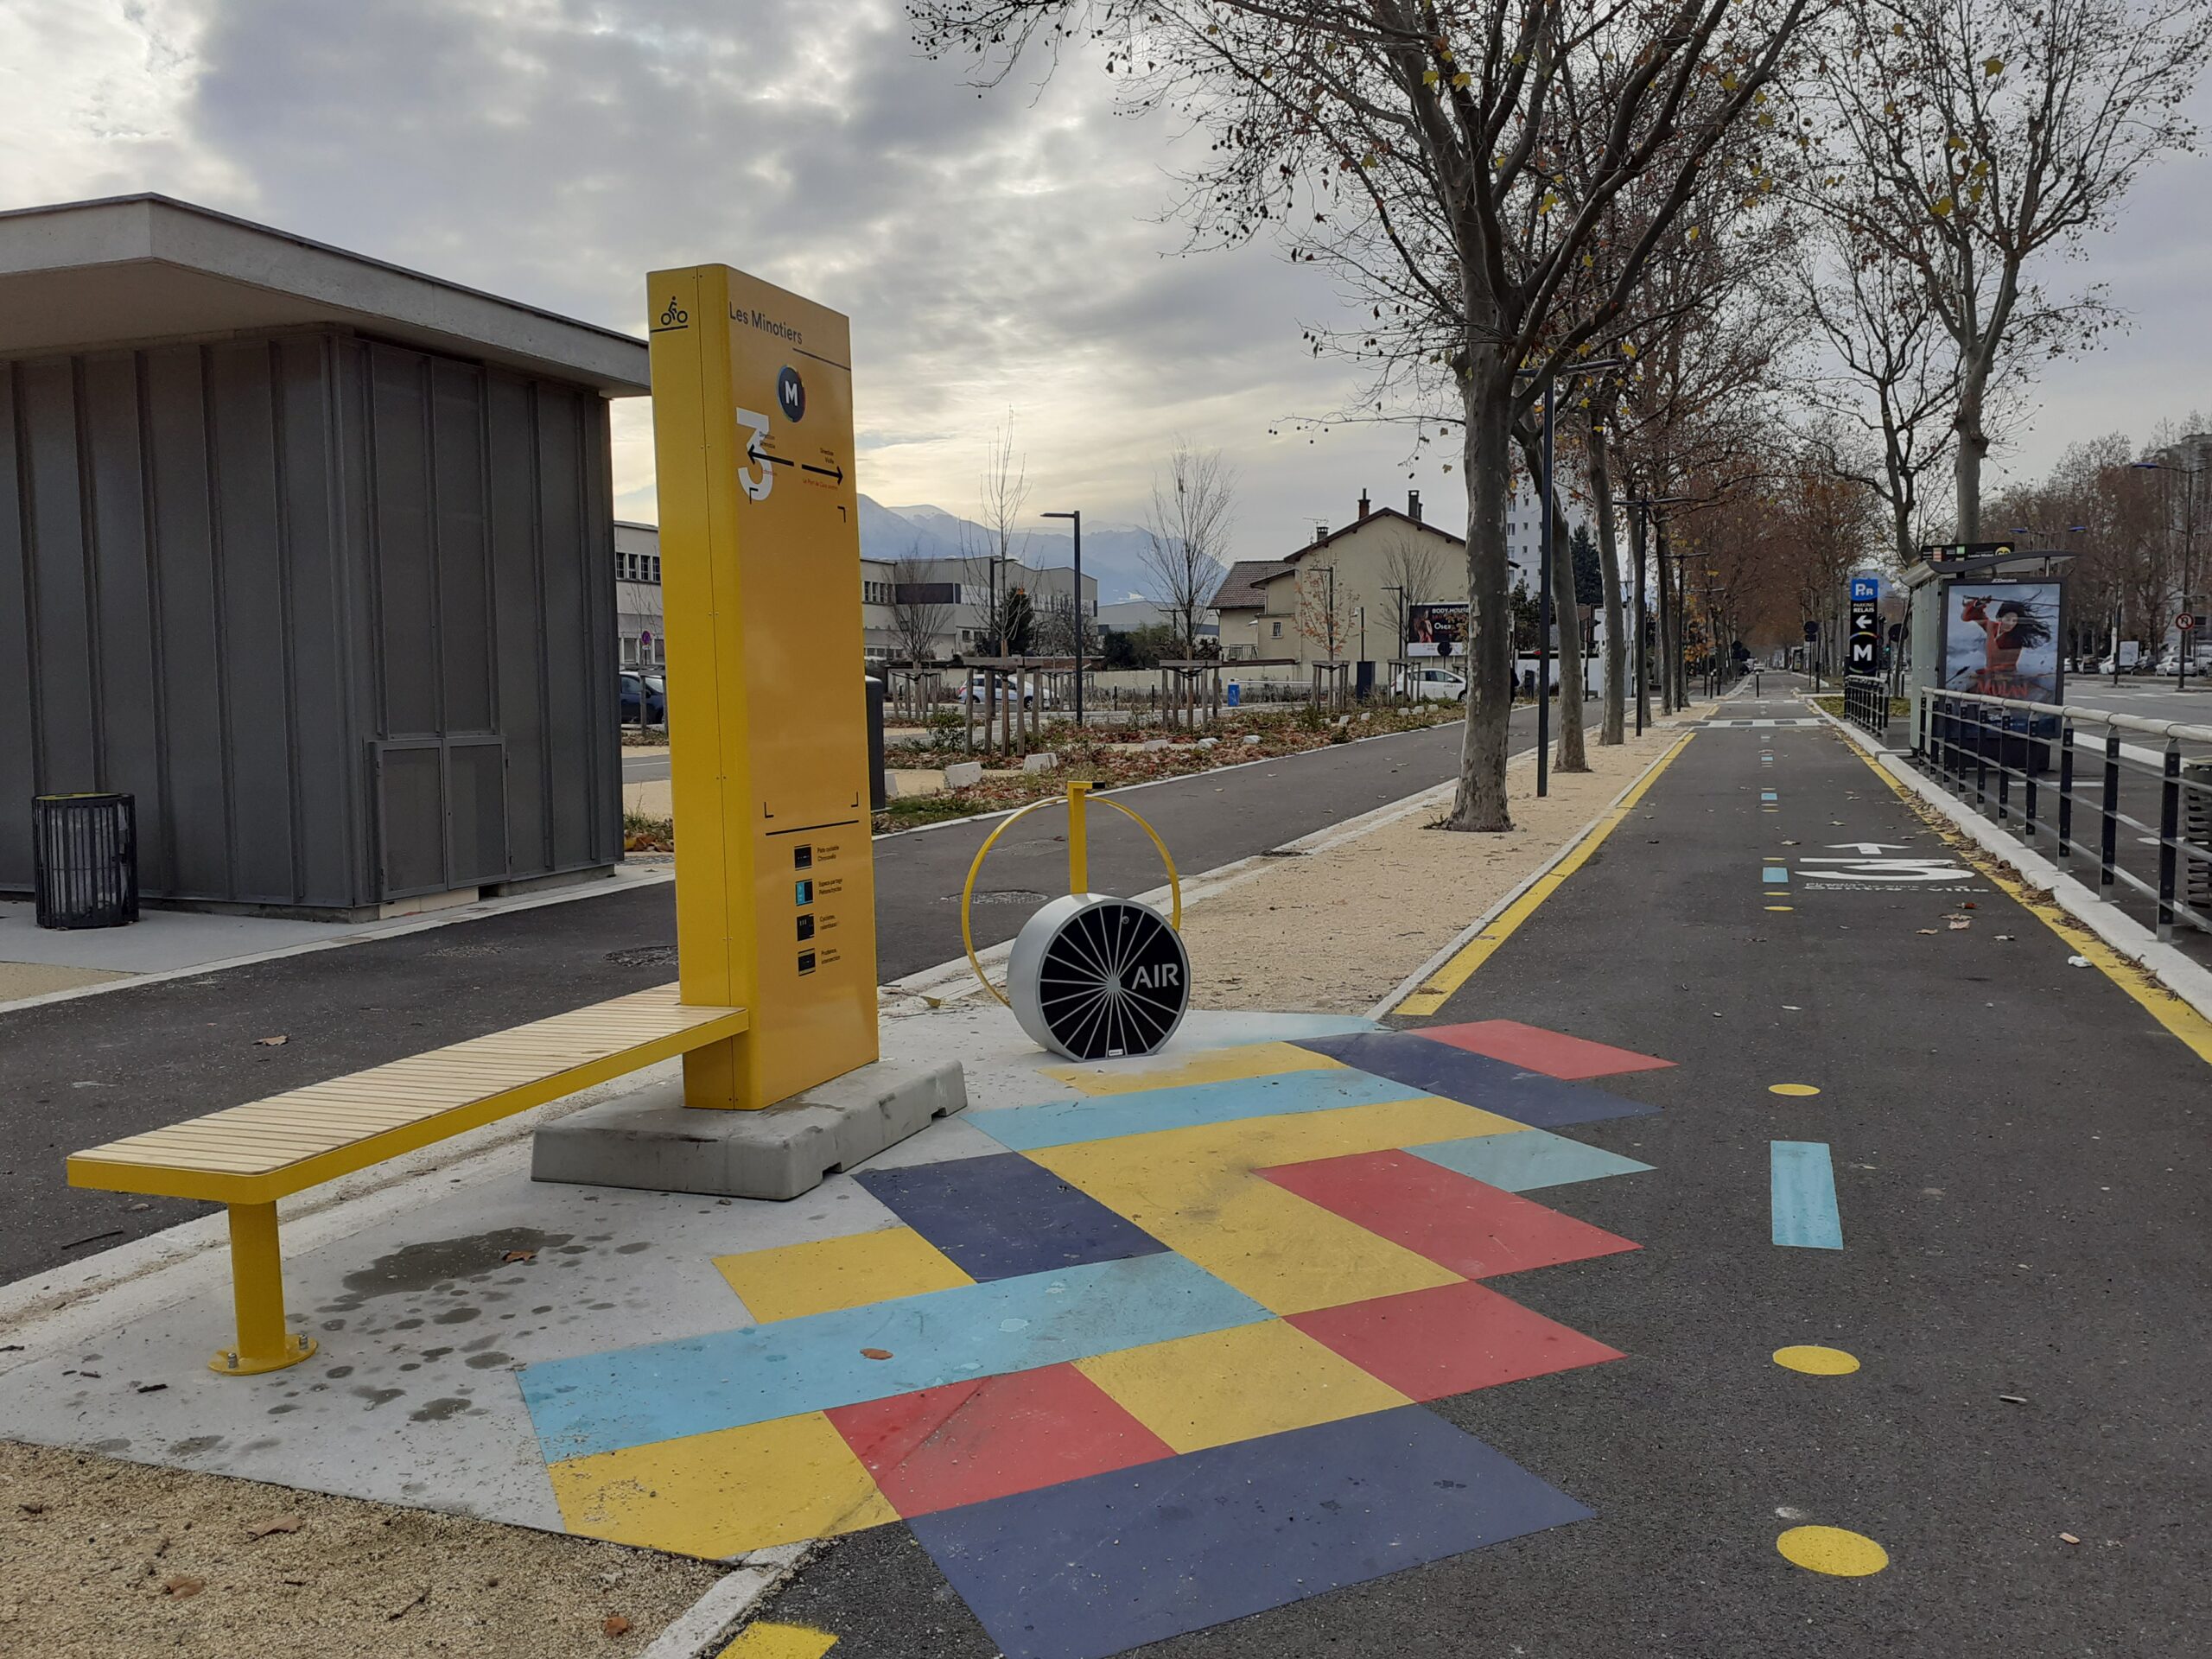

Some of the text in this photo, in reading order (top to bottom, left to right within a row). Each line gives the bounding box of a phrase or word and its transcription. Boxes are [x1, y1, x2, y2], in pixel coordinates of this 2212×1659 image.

[729, 301, 803, 344] Les Minotiers
[785, 380, 798, 407] M
[736, 407, 773, 501] 3
[1853, 644, 1872, 662] M
[1131, 963, 1180, 990] AIR
